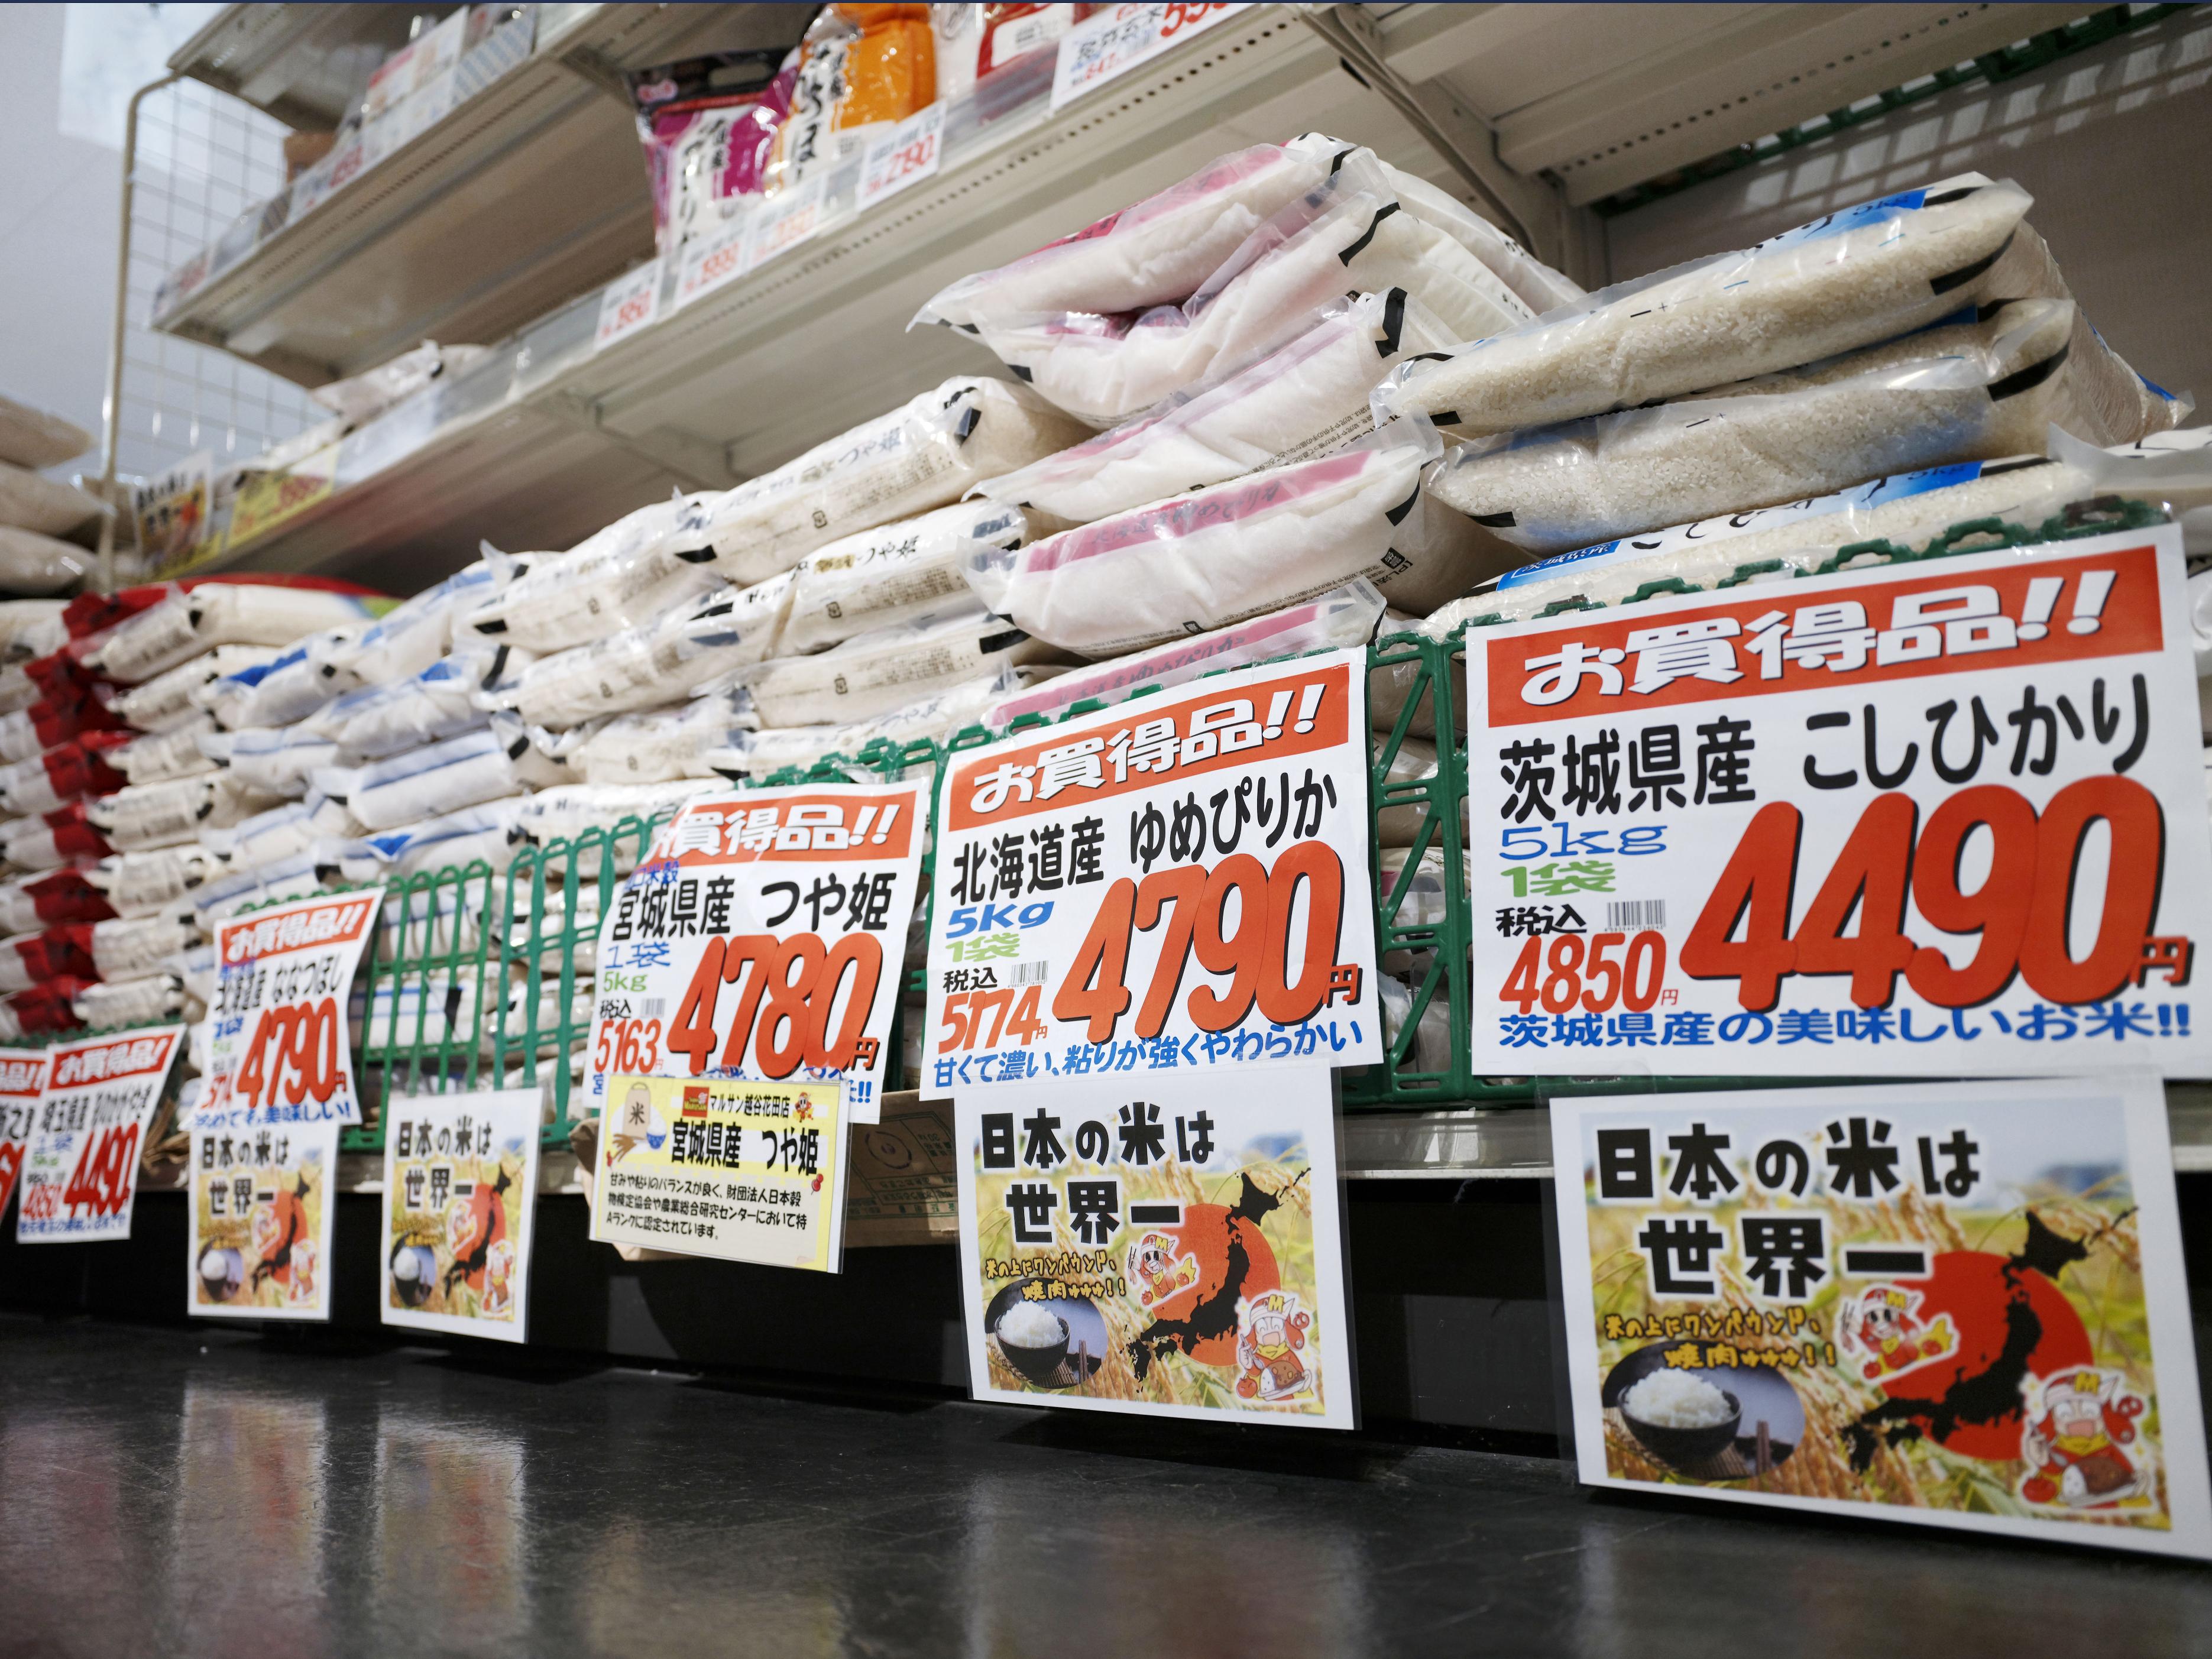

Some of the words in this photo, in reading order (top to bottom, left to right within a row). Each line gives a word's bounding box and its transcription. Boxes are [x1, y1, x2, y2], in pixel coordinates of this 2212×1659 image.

[1161, 3, 1228, 37] 59
[1520, 569, 2116, 706] お買得品!!
[970, 683, 1326, 814] お買得品!!
[1500, 716, 1756, 824] 茨城県産
[1803, 674, 2151, 790] こしひかり
[950, 816, 1105, 906] 北海道産
[1129, 767, 1337, 874] ゆめぴりか
[1499, 823, 1668, 860] 5kg
[1500, 861, 1617, 898] 1袋
[612, 874, 736, 941] 宮城県産
[761, 872, 896, 932] つや姫
[1495, 905, 1588, 937] 税込
[226, 903, 365, 961] お買得品!!
[945, 932, 1020, 964] 1袋
[272, 953, 343, 1003] ななつぼし
[604, 941, 671, 970] 1袋
[603, 971, 648, 993] 5kg
[943, 969, 998, 993] 税込
[600, 999, 632, 1019] 税込
[1498, 1002, 2192, 1049] 茨城県産の美味しいお米!!
[629, 1102, 645, 1125] 米
[710, 1093, 791, 1119] マルサン越谷花田店
[399, 1114, 492, 1157] 日本の米は
[672, 1118, 742, 1169] 宮城県産
[762, 1126, 820, 1177] つや姫
[981, 1101, 1215, 1168] 日本の米は
[1596, 1117, 1980, 1200] 日本の米は
[406, 1168, 472, 1208] 世界一
[1006, 1181, 1180, 1244] 世界一
[1639, 1217, 1926, 1298] 世界一
